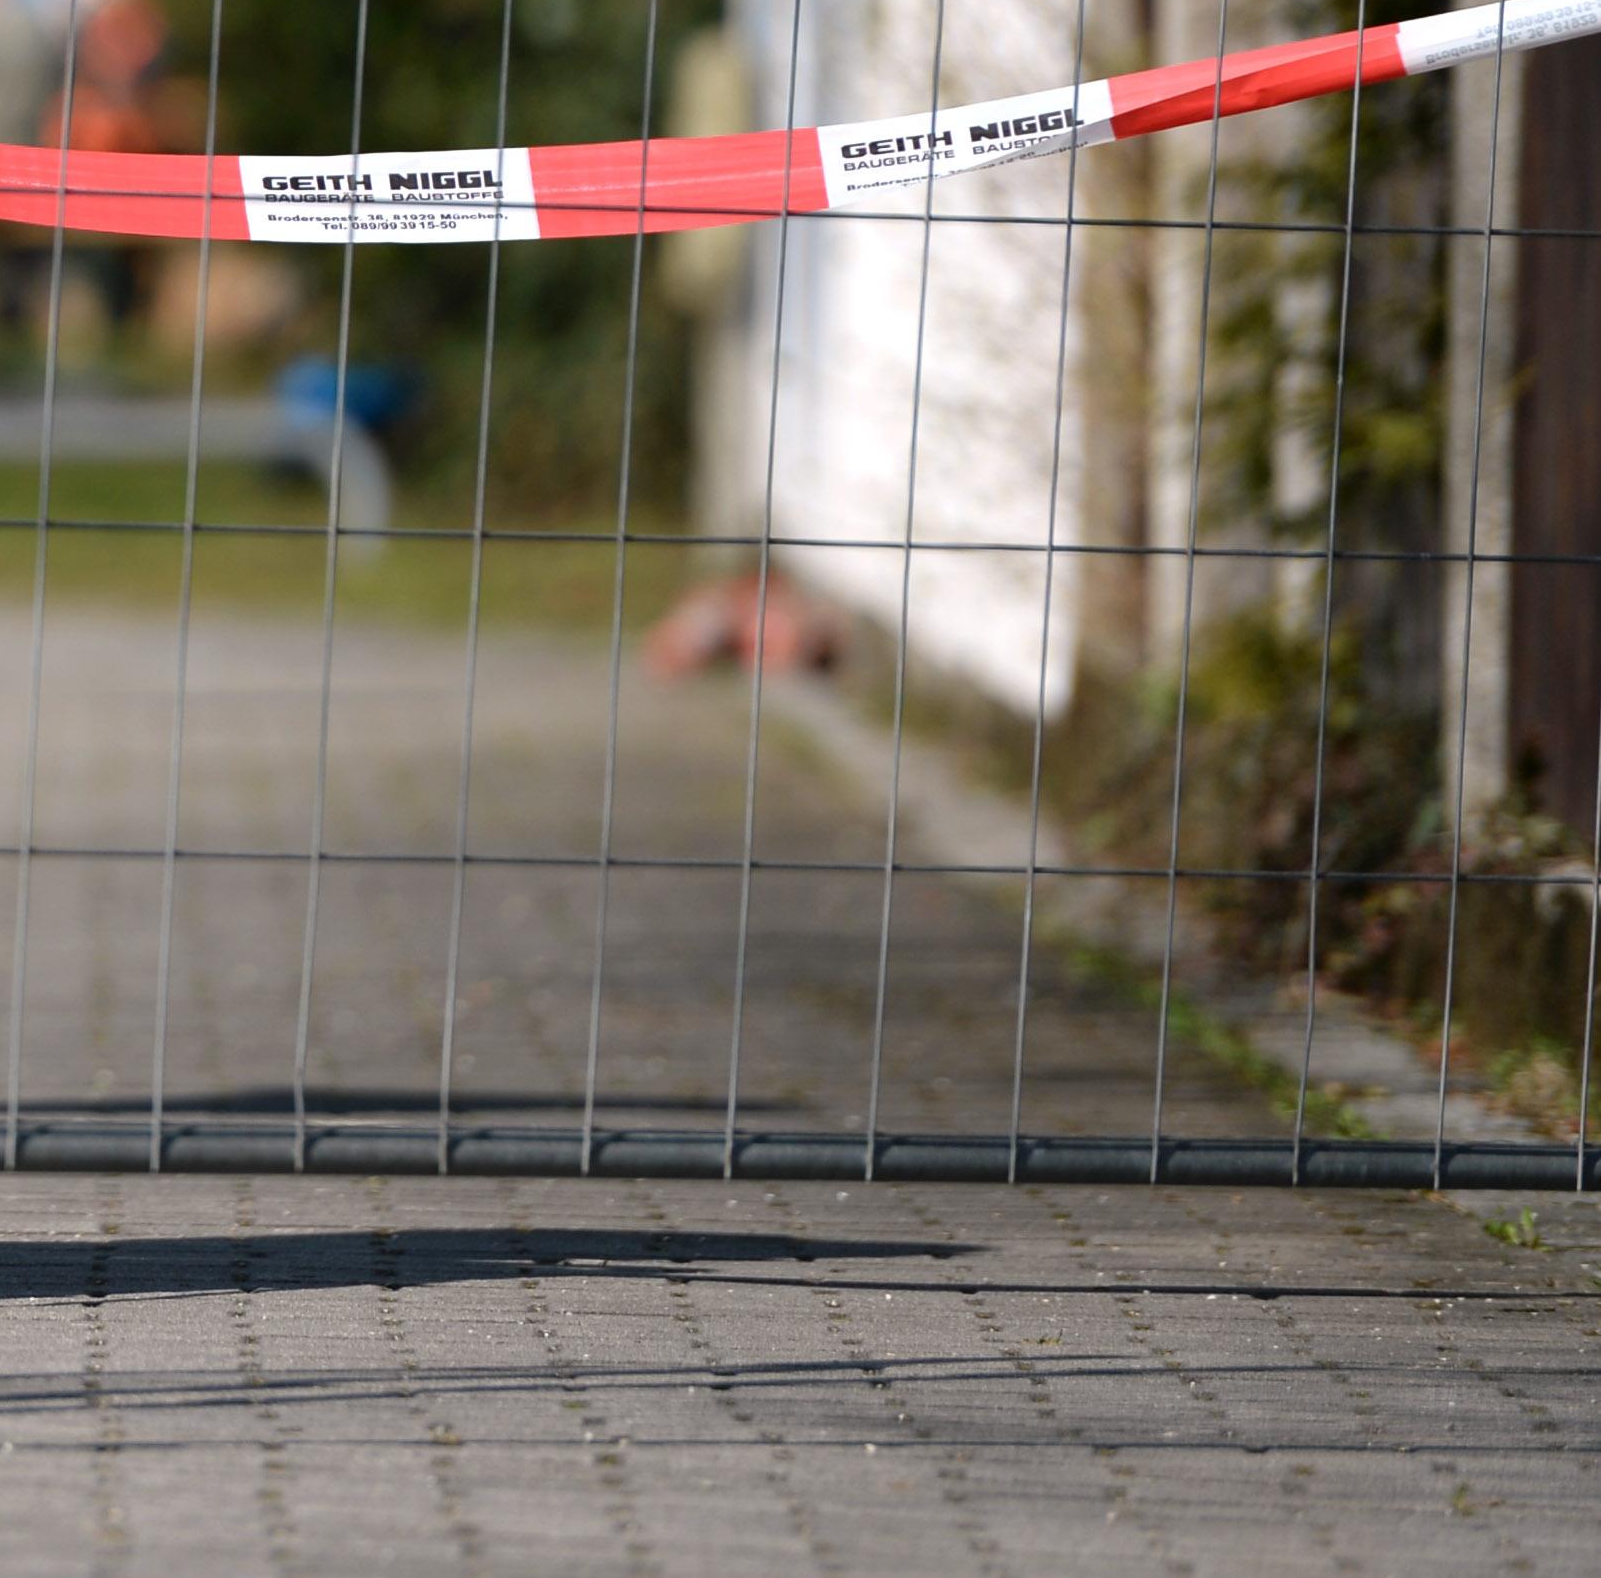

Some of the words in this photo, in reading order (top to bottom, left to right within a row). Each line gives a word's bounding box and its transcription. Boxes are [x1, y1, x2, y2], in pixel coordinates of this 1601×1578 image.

[840, 130, 952, 159] GEITH
[969, 108, 1085, 142] NIGGL
[843, 149, 956, 172] BAUGERÄTE
[262, 174, 373, 191] GEITH
[388, 170, 503, 190] NIGGL
[264, 191, 375, 203] BAUGERÄTE
[391, 190, 505, 202] BAUSTOFFE
[267, 213, 360, 222] Brodersenstr.
[440, 211, 508, 221] München,
[321, 221, 348, 231] Tel.
